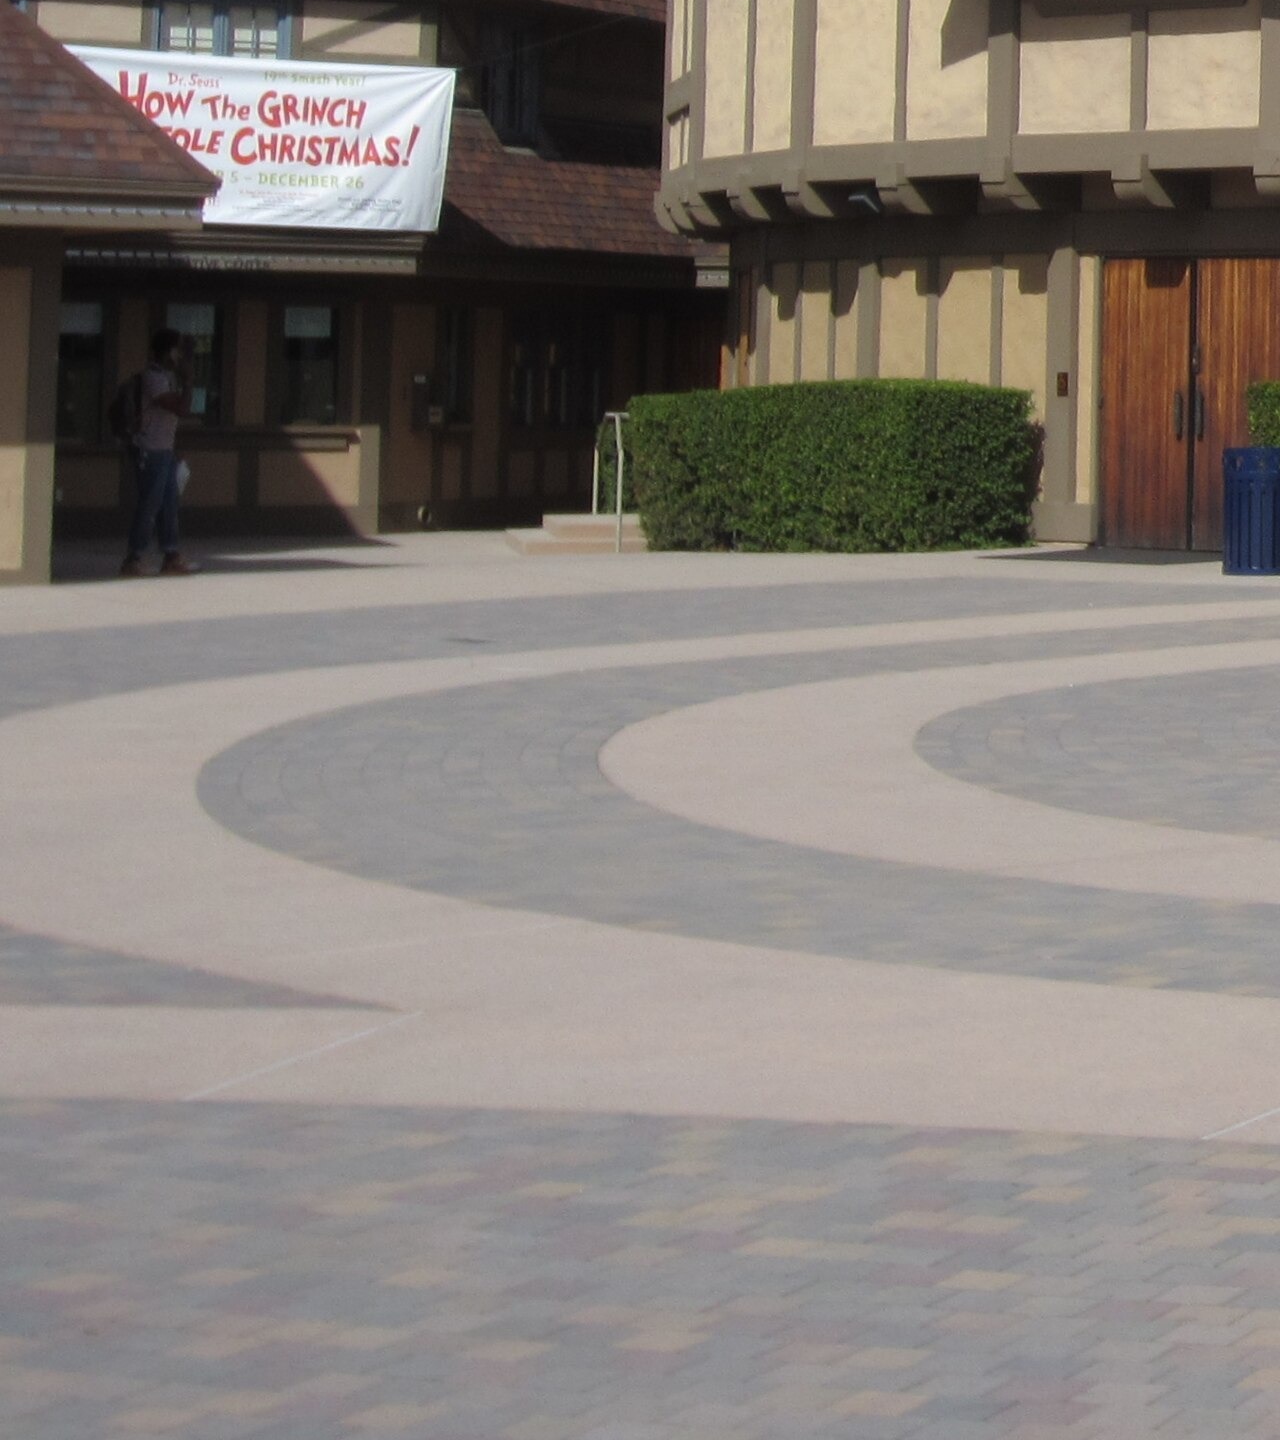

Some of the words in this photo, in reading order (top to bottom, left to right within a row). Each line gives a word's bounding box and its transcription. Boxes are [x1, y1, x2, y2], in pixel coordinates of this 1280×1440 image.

[168, 72, 186, 86] Dr.
[292, 71, 331, 85] Smash
[119, 70, 195, 120] HOW
[257, 90, 367, 129] GRINCH
[160, 125, 225, 155] OLE
[230, 125, 421, 167] CHRISTMAS!
[231, 170, 239, 184] 5
[258, 173, 338, 189] DECEMBER
[345, 175, 364, 189] 26
